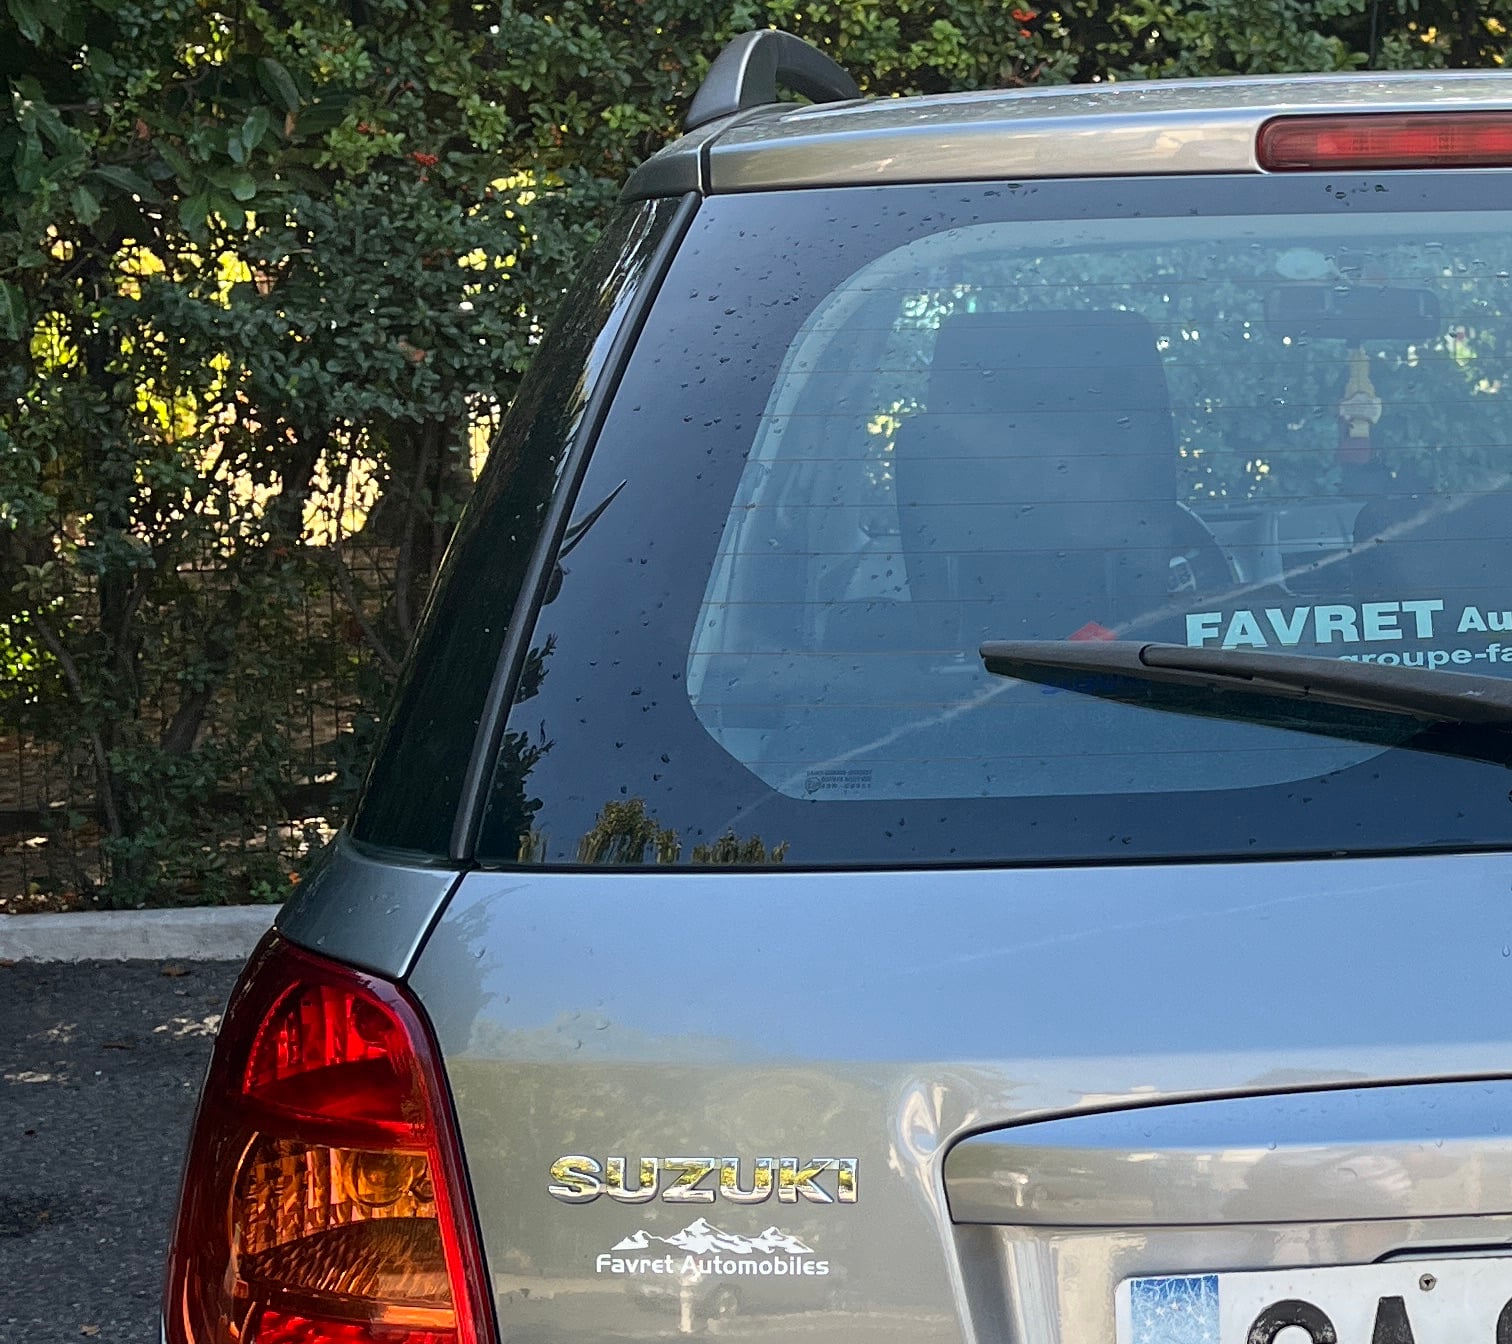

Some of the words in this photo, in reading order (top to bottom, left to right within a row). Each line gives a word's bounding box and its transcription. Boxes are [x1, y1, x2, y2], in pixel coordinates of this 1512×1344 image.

[1185, 599, 1445, 650] FAVRET
[548, 1155, 860, 1205] SUZUKI
[596, 1253, 674, 1275] Favret
[680, 1254, 830, 1276] Automobiles
